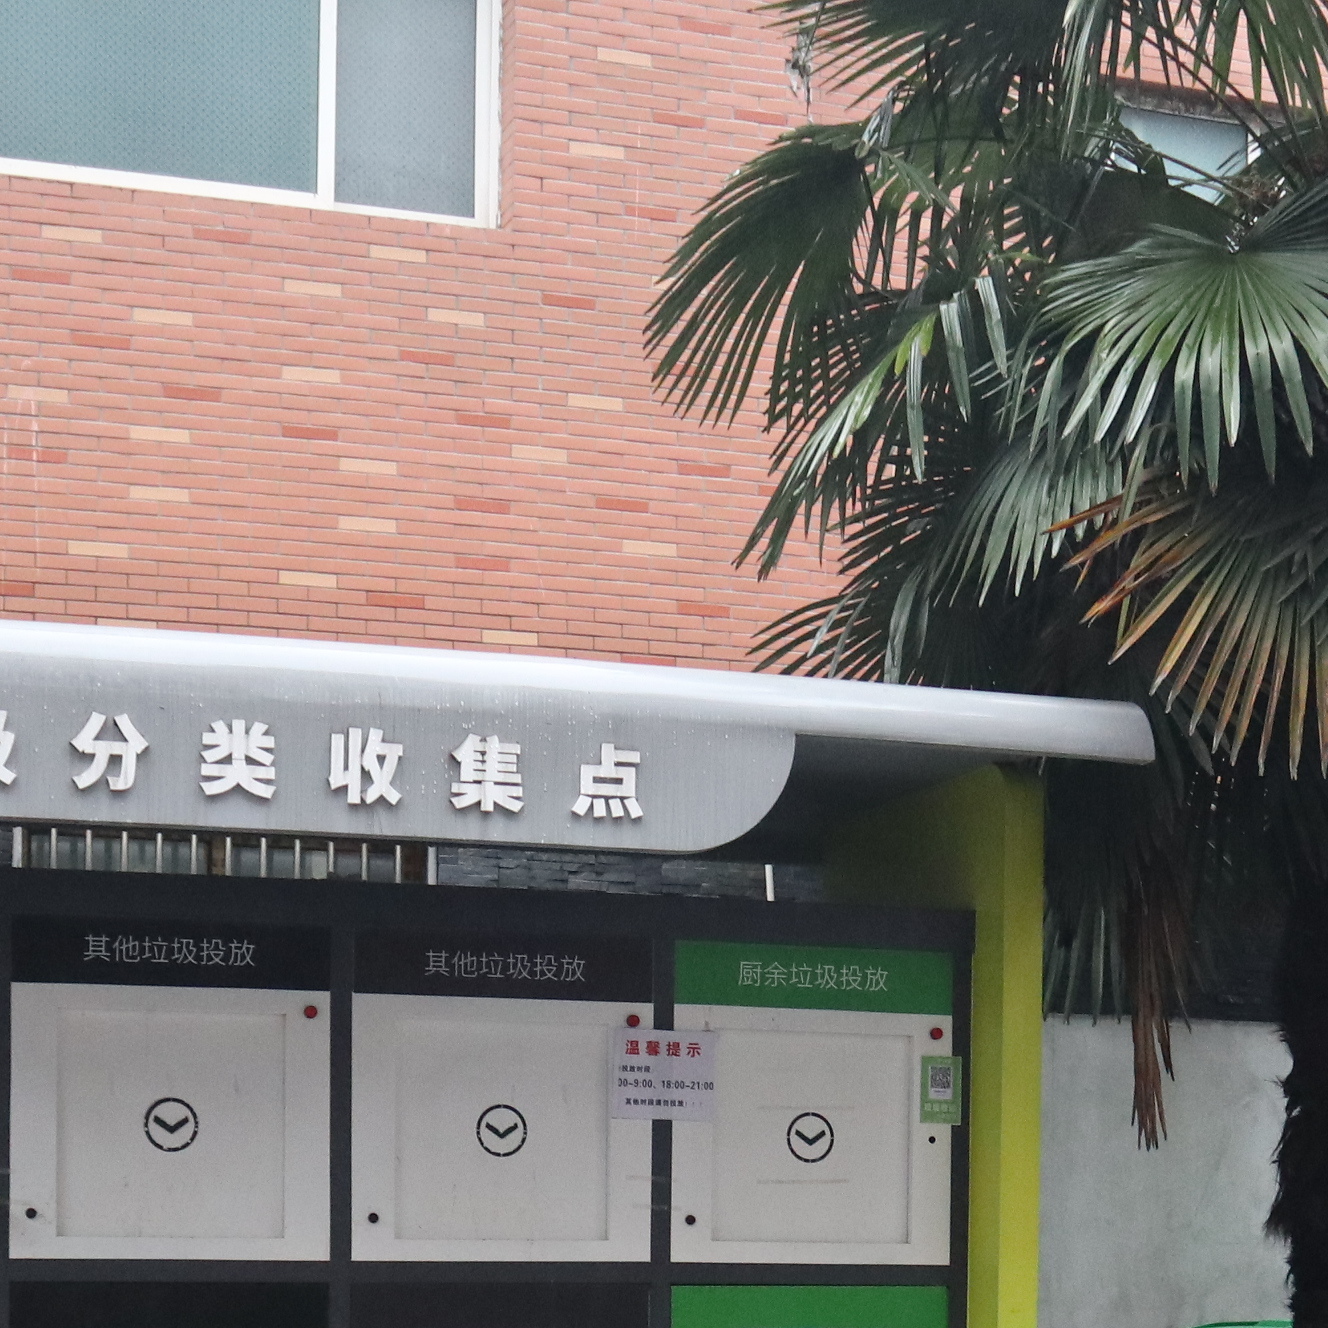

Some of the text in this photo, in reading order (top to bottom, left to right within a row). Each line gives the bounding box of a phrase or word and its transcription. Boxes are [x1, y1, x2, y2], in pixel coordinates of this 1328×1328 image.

[83, 933, 256, 967] 其他垃圾投放
[424, 949, 586, 982] 其他垃圾投放
[737, 960, 889, 992] 厨余垃圾投放
[625, 1039, 701, 1058] 温馨提示
